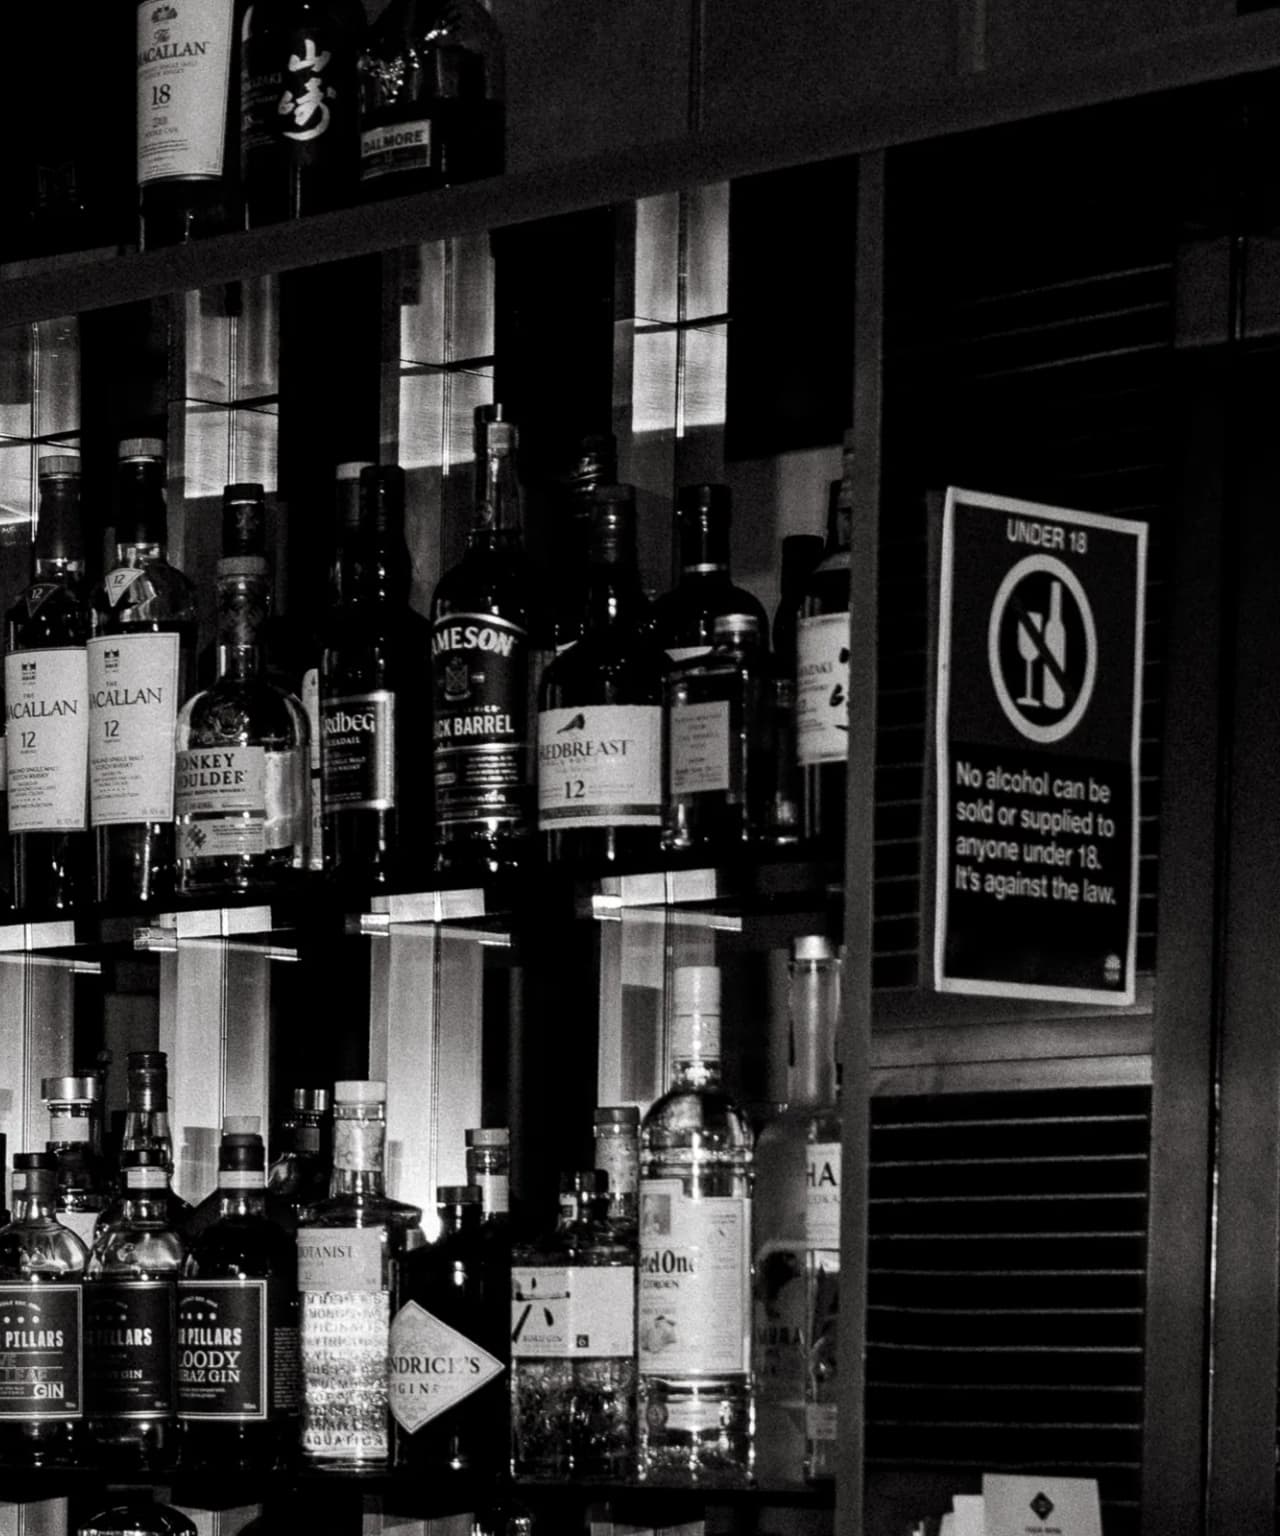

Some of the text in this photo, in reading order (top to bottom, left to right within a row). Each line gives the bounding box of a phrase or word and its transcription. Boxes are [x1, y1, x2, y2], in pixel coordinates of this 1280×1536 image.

[140, 41, 207, 63] ACALLAN
[151, 83, 171, 106] 18
[363, 129, 424, 151] DALMORE
[1006, 518, 1088, 554] UNDER 18
[113, 574, 126, 586] 12
[431, 626, 515, 657] MESON
[90, 687, 163, 709] ACALLAN
[7, 699, 79, 720] ACALLAN
[104, 719, 121, 738] 12
[324, 711, 376, 734] rdbeg
[453, 714, 515, 736] BARREL
[20, 731, 37, 749] 12
[181, 753, 235, 771] ONKEY
[182, 770, 246, 789] OULDER
[956, 760, 1111, 804] No alcohol can be
[564, 780, 586, 799] 12
[956, 797, 1115, 837] sold or supplied to
[955, 835, 1102, 870] anyone under 18.
[955, 863, 1117, 905] It's against the law.
[301, 1245, 354, 1260] OTANIST
[5, 1330, 64, 1348] PILLARS
[187, 1327, 243, 1346] PILLARS
[179, 1350, 242, 1369] OODY
[390, 1356, 481, 1375] NDRIC'S
[121, 1369, 144, 1380] GIN
[208, 1370, 241, 1384] GIN
[33, 1383, 65, 1399] GIN
[399, 1383, 429, 1395] GIN
